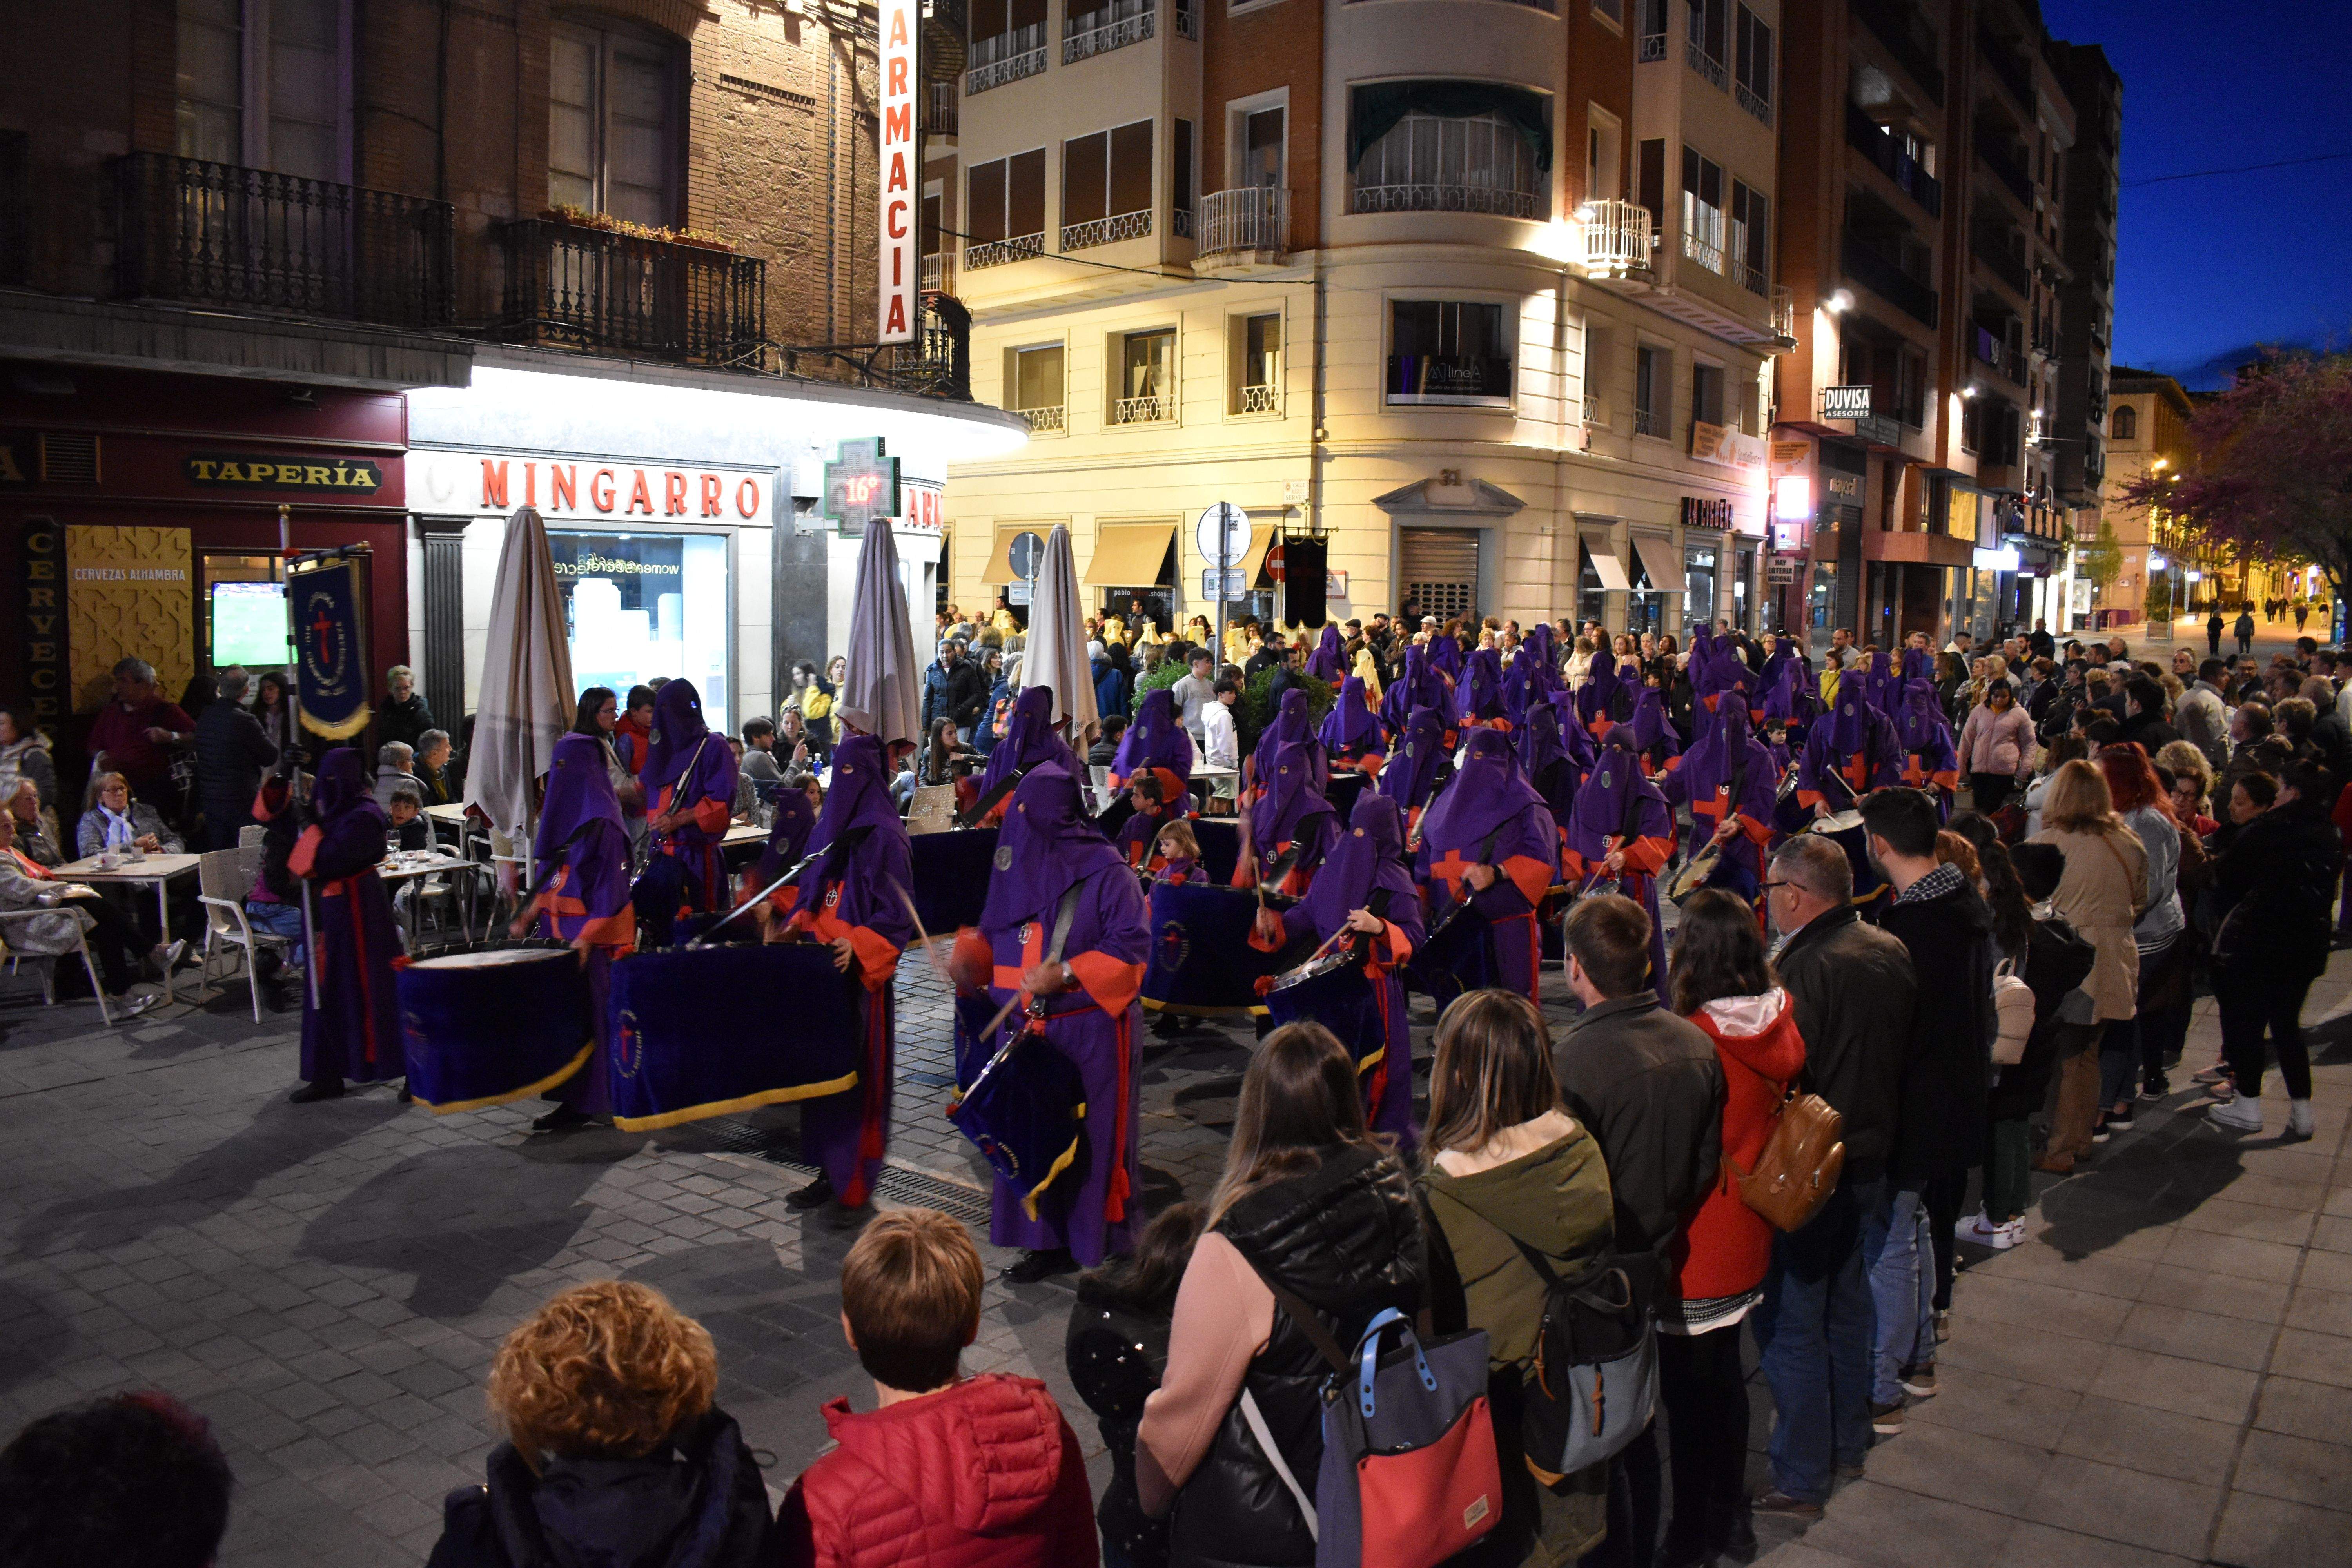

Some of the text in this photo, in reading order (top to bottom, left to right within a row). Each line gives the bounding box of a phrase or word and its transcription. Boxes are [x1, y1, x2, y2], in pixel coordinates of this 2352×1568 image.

[1826, 388, 1870, 409] DUVISA
[191, 460, 377, 487] TAPERÍA
[1439, 468, 1463, 486] 31
[480, 459, 760, 517] MINGARRO
[73, 569, 185, 581] CERVEZAS ALHAMBRA
